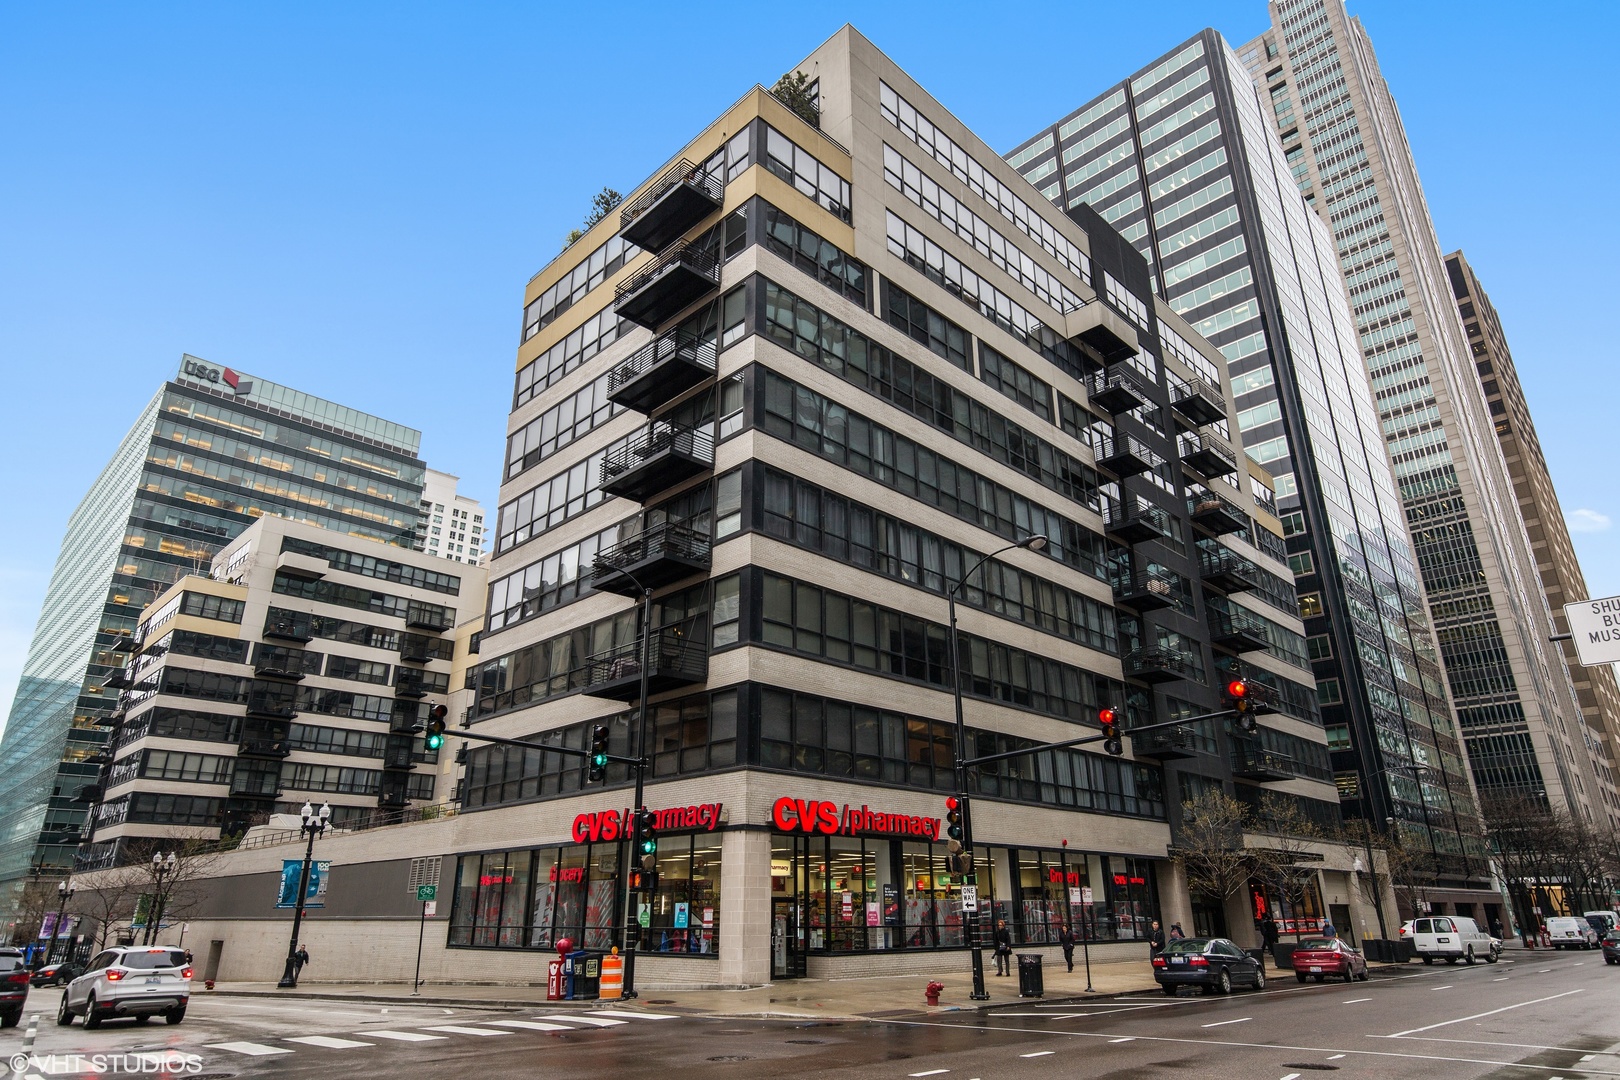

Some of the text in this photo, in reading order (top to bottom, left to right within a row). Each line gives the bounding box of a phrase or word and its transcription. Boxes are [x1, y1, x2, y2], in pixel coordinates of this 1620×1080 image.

[185, 360, 220, 383] USG
[572, 803, 723, 843] CVS/parmacy
[772, 796, 941, 841] CVS/pharmacy
[550, 866, 584, 883] Gocery
[1050, 868, 1079, 887] Groery
